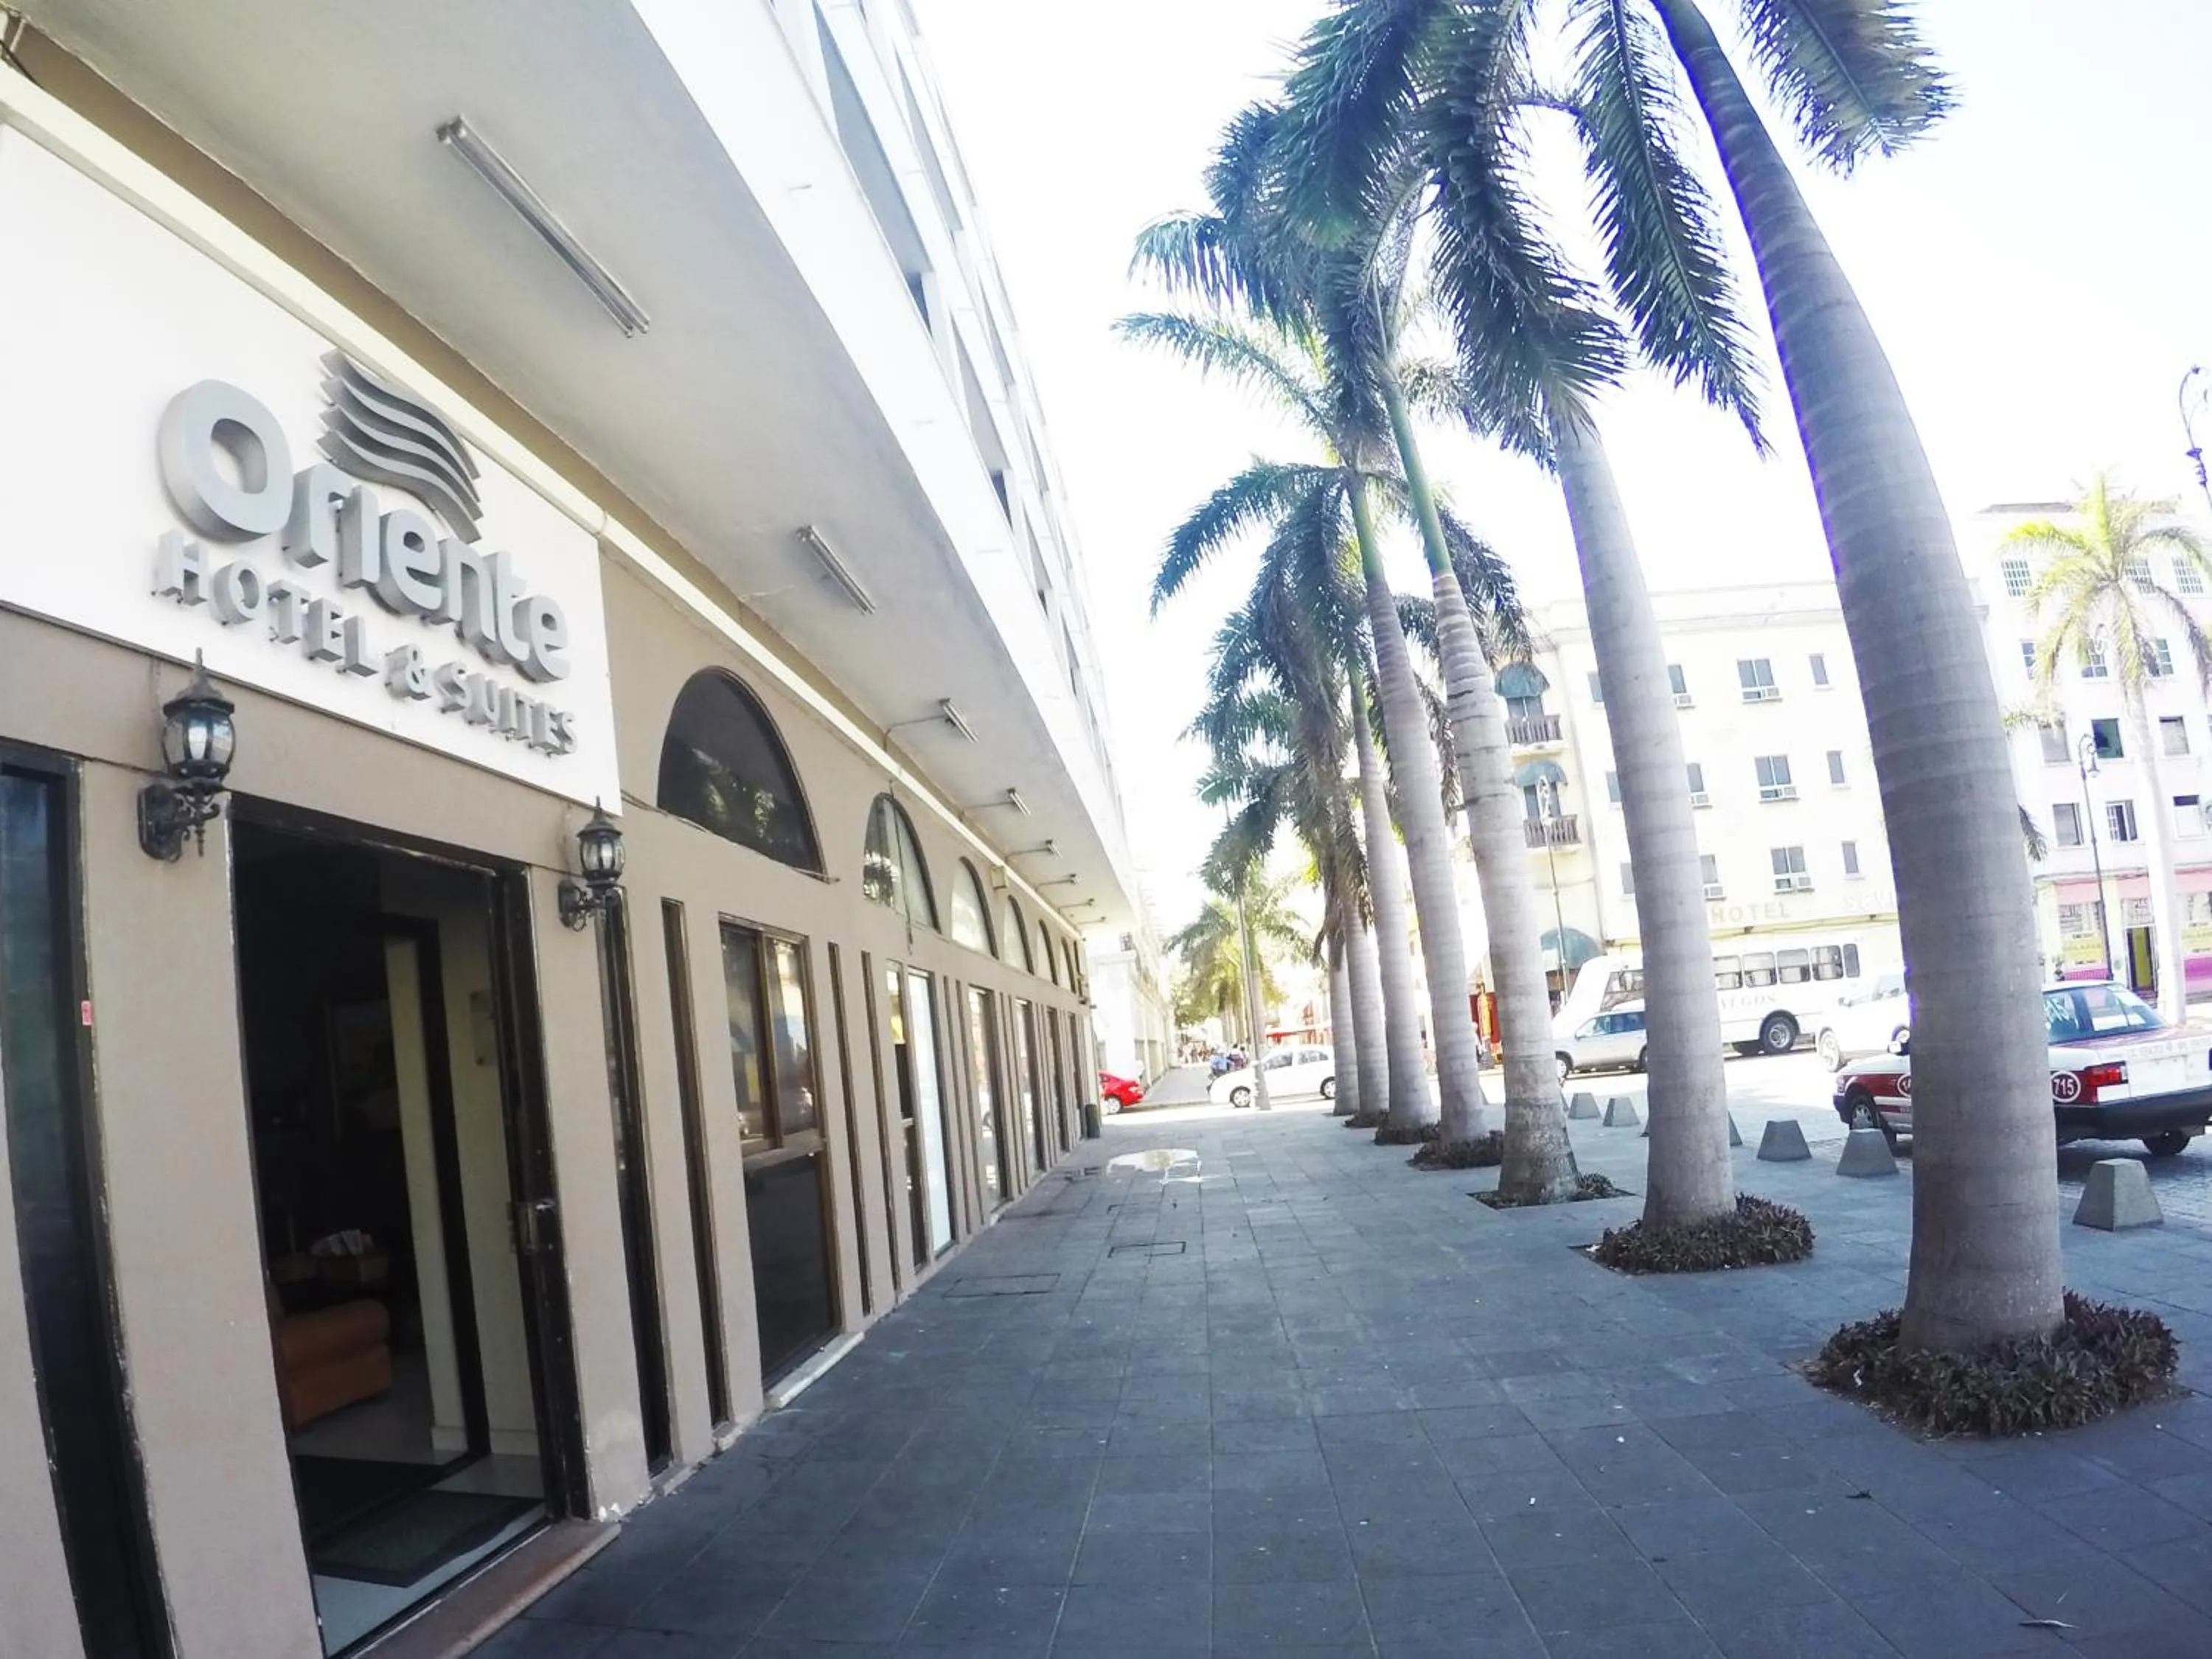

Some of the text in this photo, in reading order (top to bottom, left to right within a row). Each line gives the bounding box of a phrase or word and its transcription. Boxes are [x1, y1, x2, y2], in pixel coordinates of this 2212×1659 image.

[157, 378, 571, 684] Oriente
[155, 529, 379, 677] HOTEL
[434, 662, 578, 757] SUITES
[1711, 901, 1790, 923] HOTEL
[2053, 1078, 2074, 1096] 715
